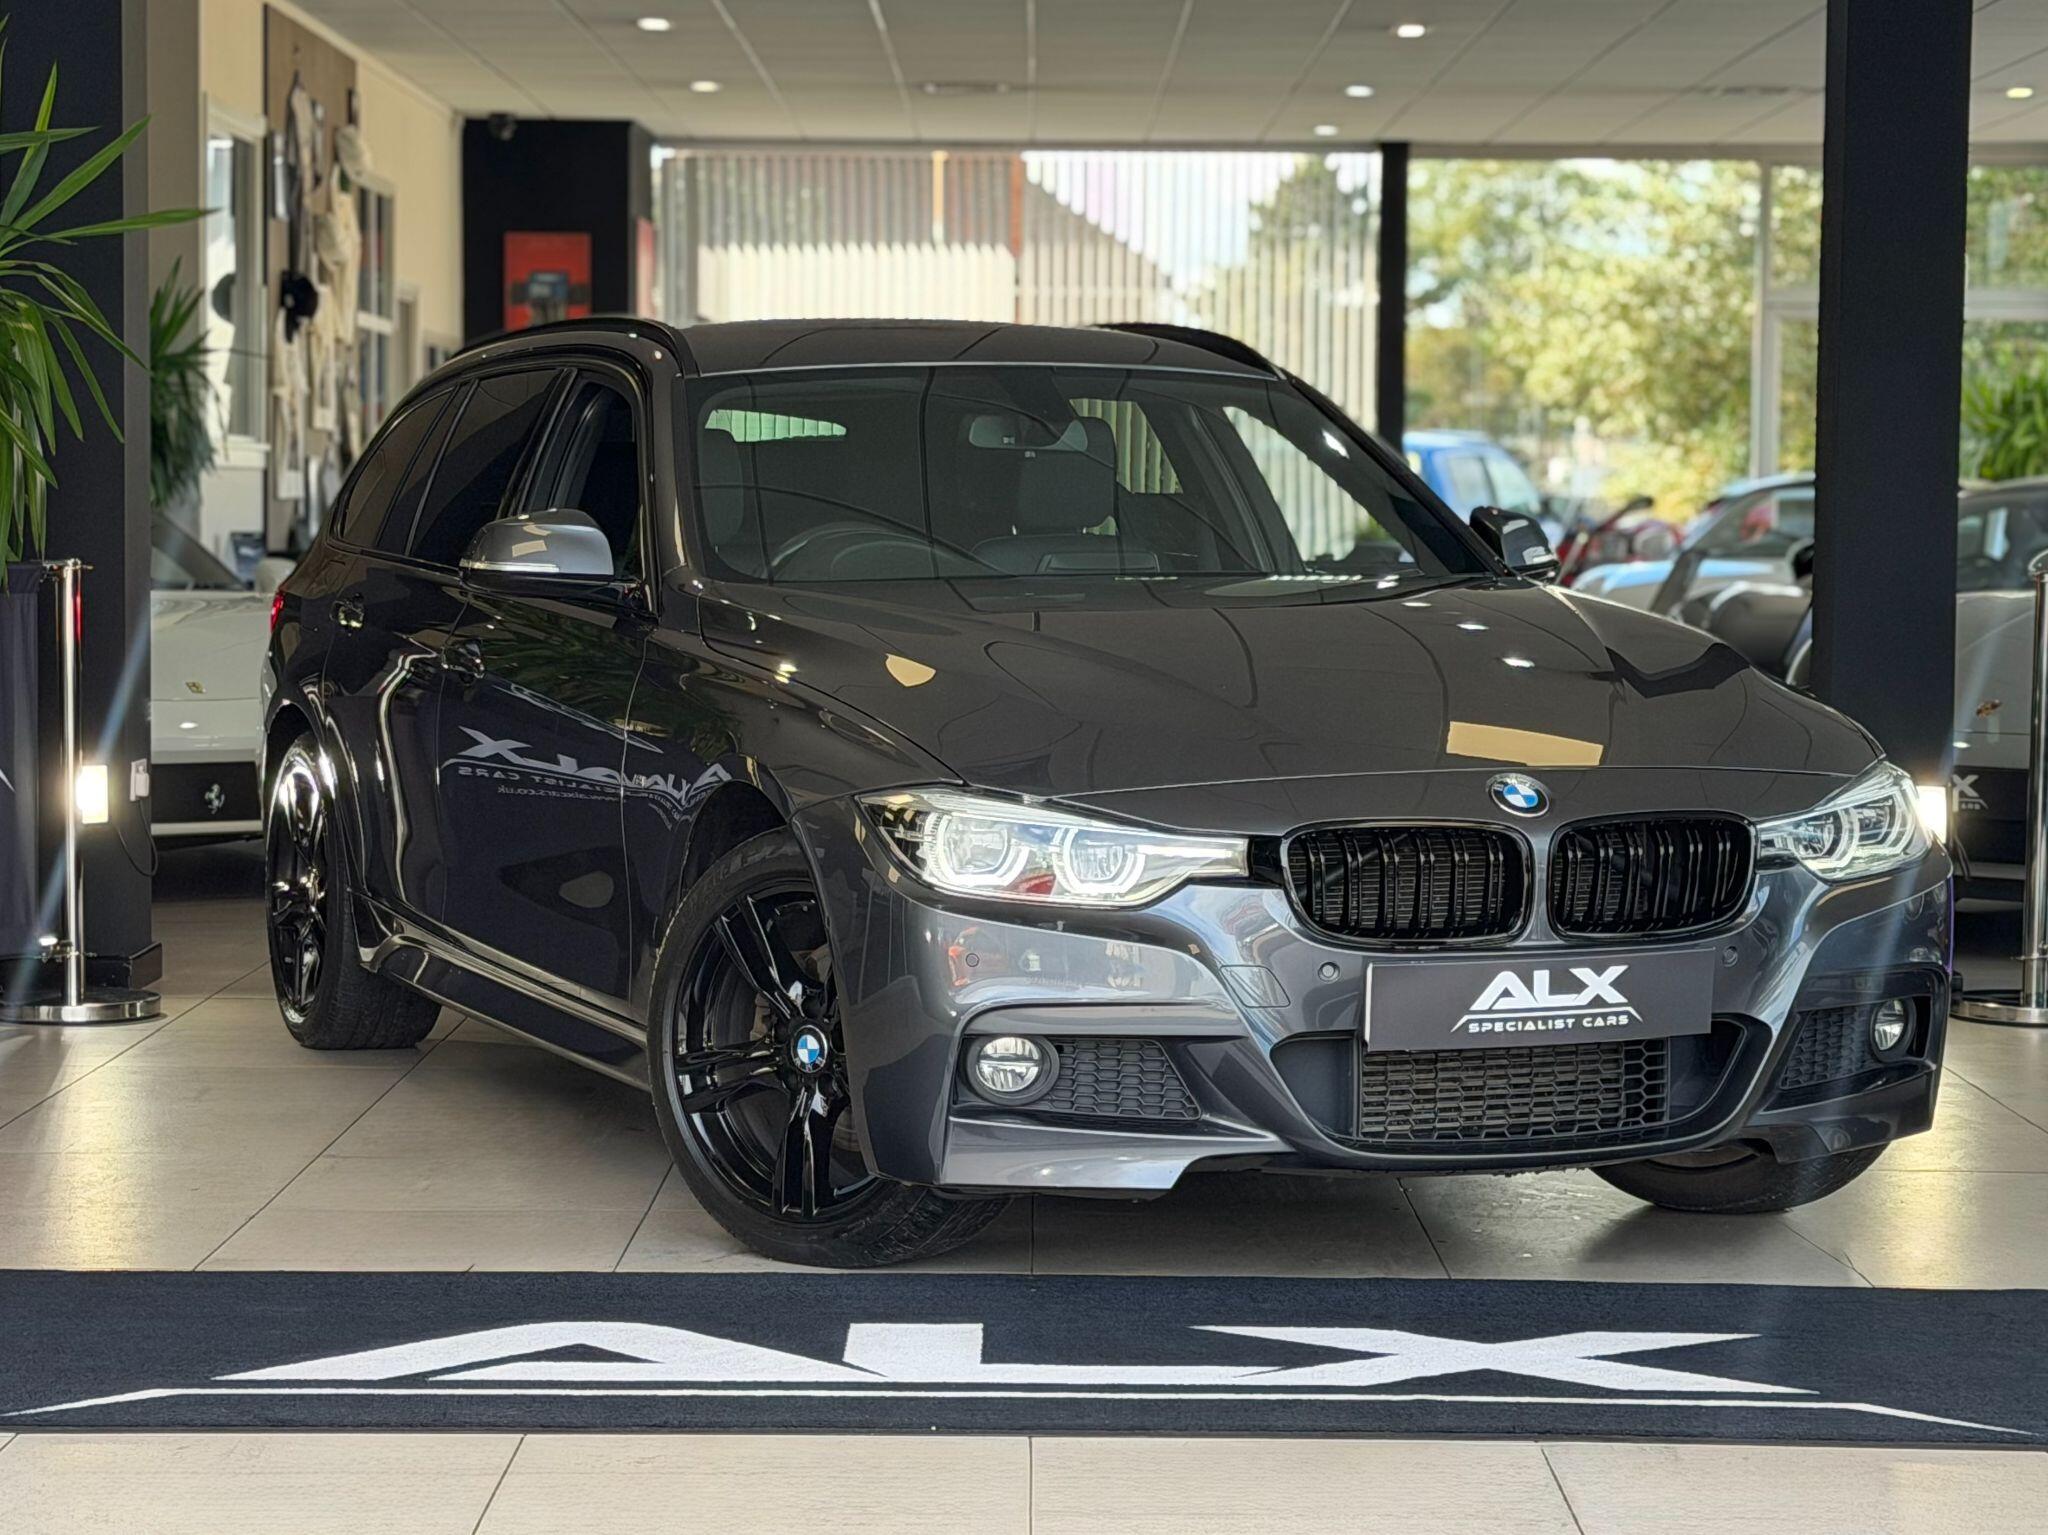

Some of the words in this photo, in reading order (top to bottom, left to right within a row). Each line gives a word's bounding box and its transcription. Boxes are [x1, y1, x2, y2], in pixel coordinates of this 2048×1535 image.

[1469, 965, 1630, 1011] ALX
[1468, 1018, 1576, 1033] SPECIALIST
[1582, 1015, 1630, 1027] CARS
[209, 1321, 1821, 1395] ALX
